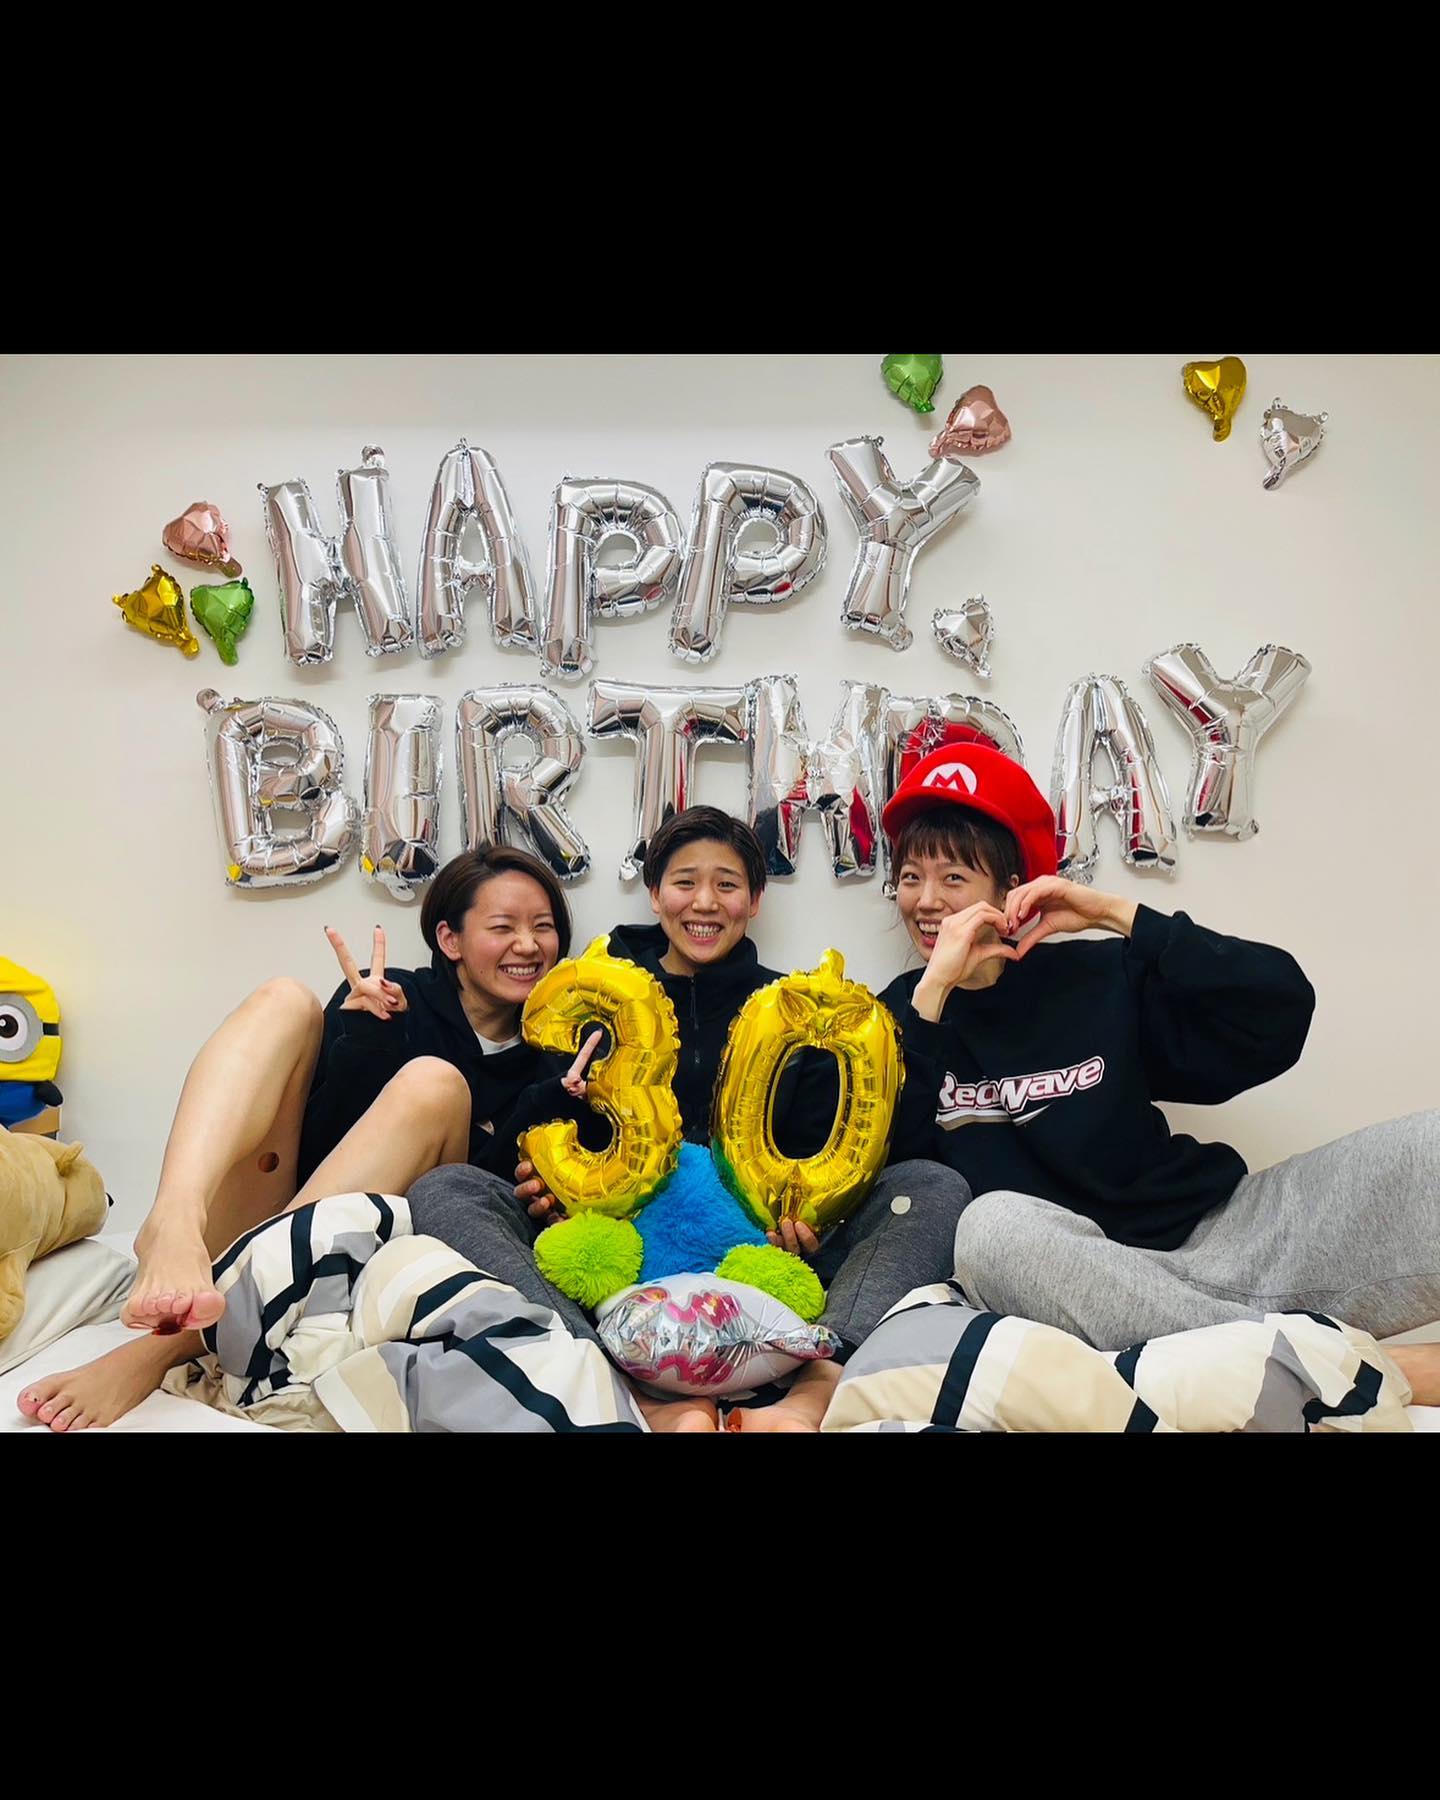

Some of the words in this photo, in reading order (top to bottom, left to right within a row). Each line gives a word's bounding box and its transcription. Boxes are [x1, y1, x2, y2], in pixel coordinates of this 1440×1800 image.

[259, 436, 982, 681] HAPPY
[931, 768, 971, 794] M
[517, 935, 907, 1236] 30
